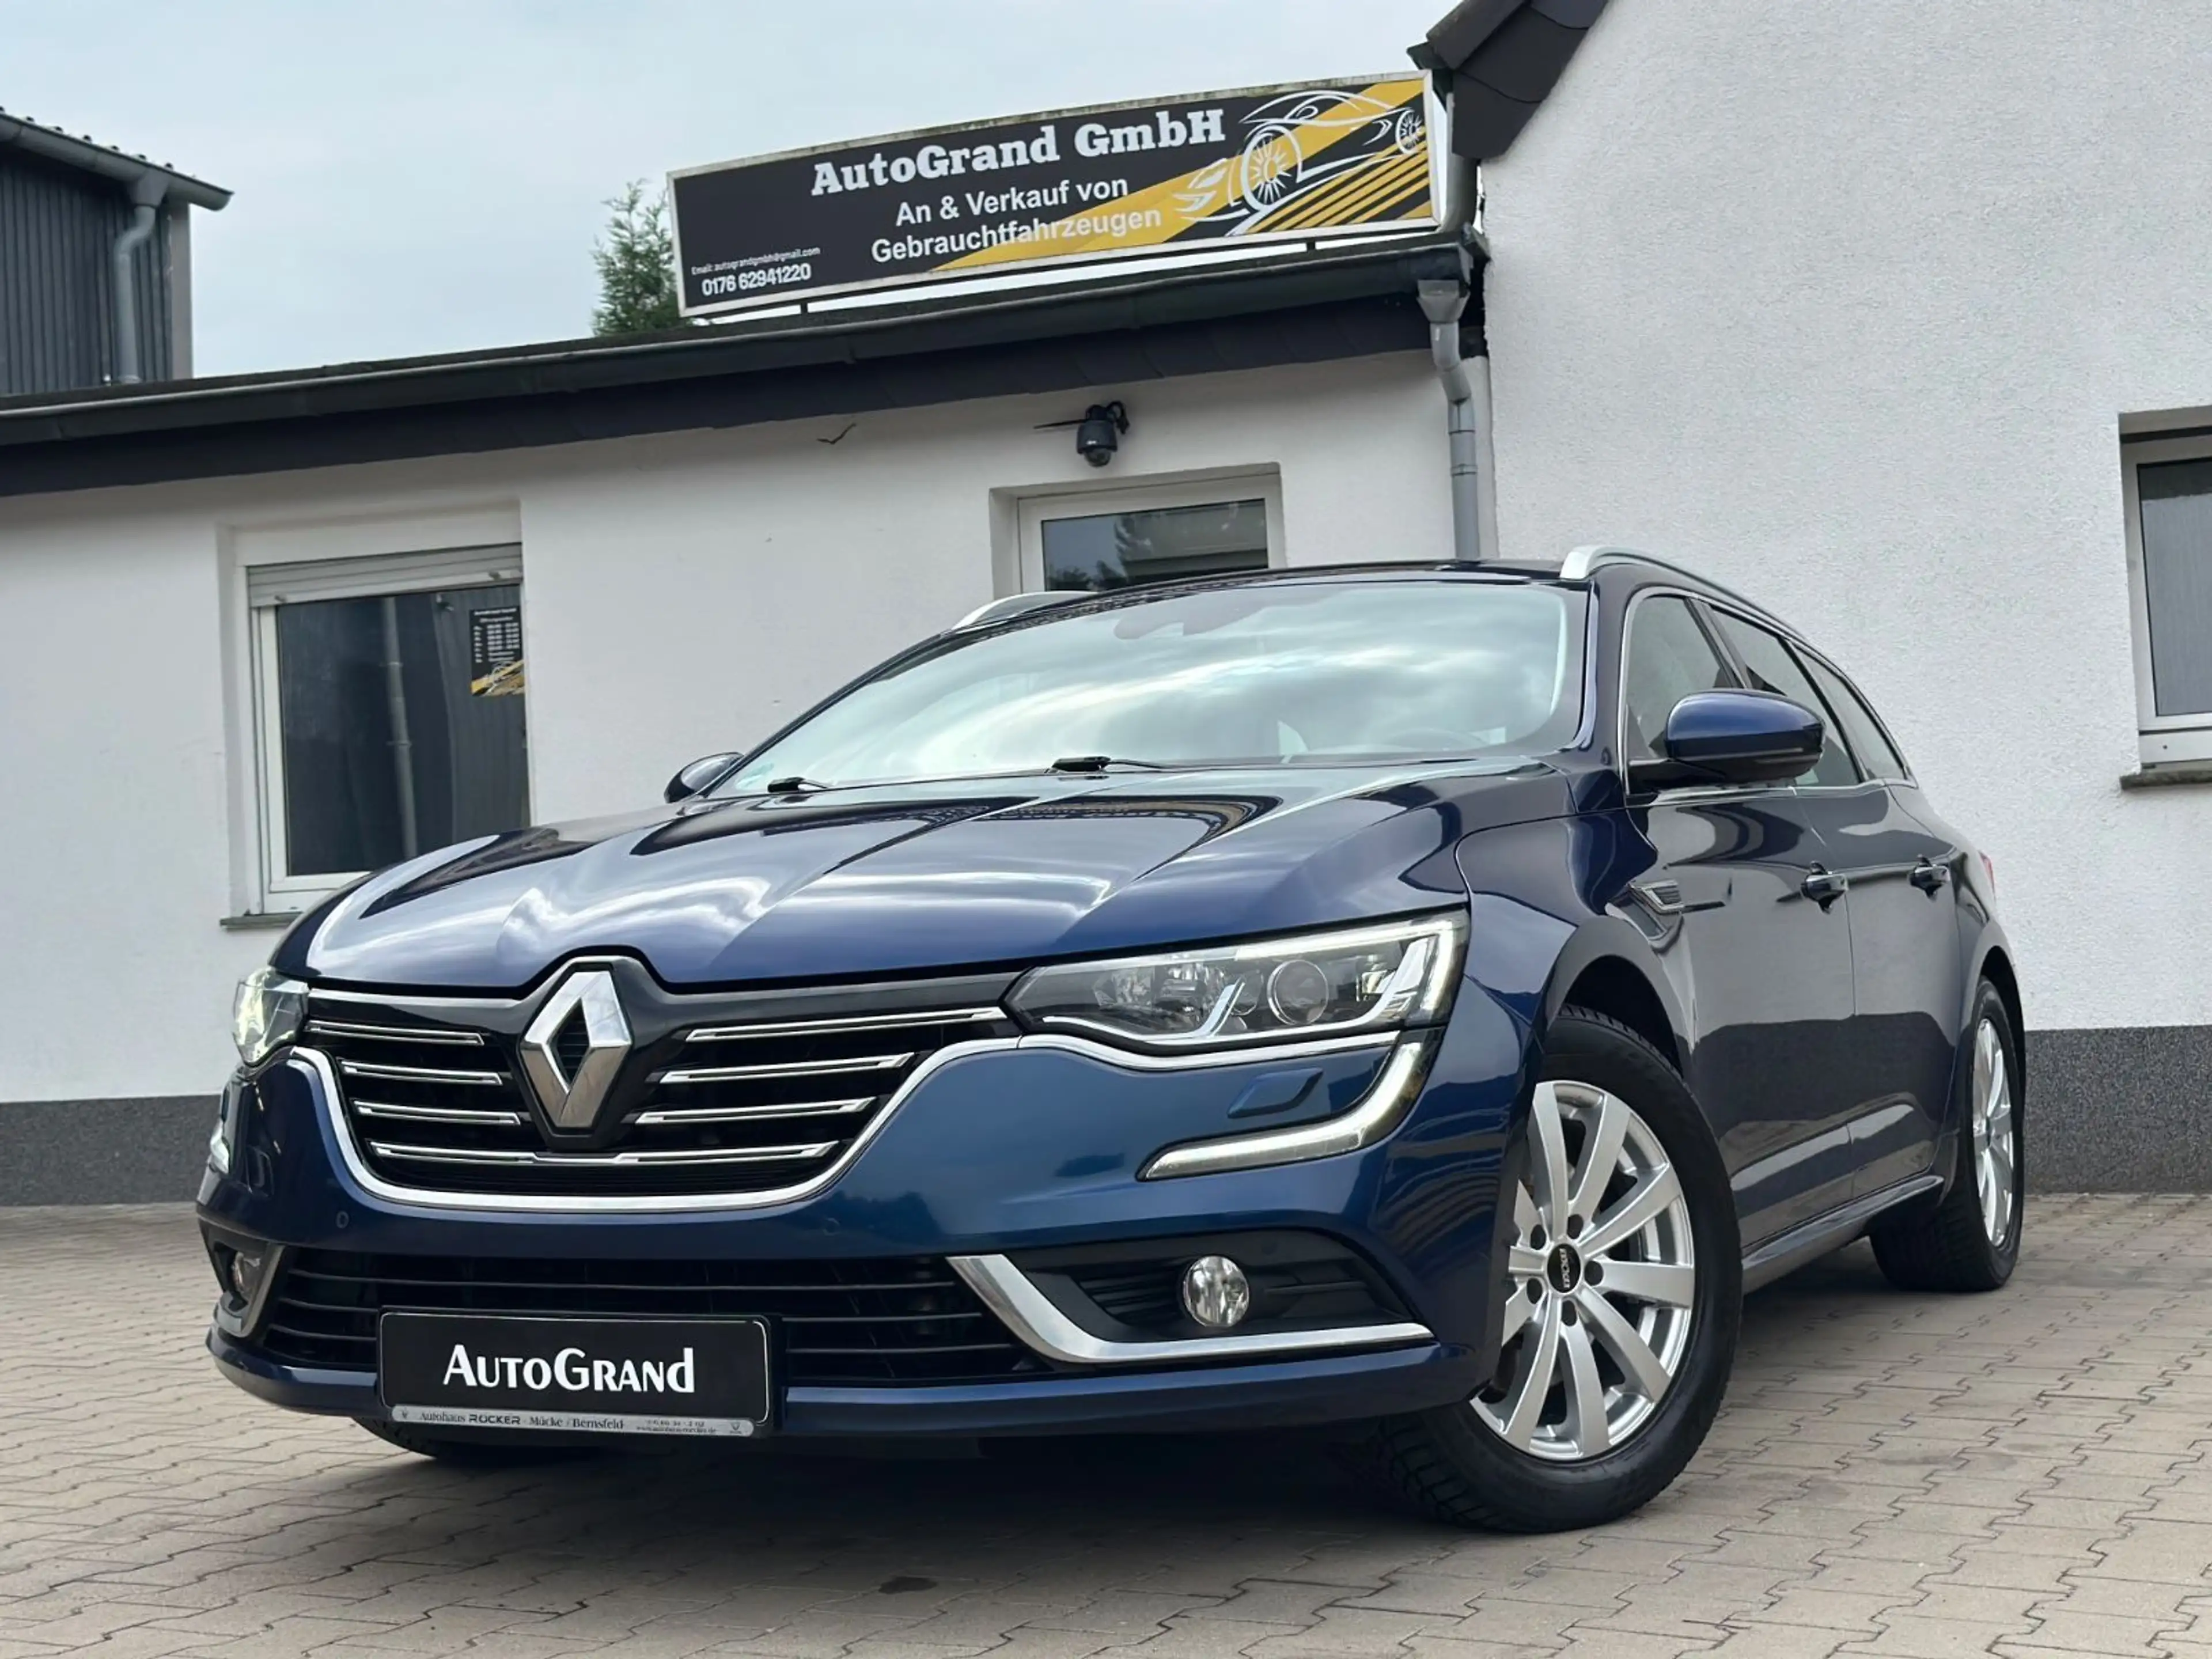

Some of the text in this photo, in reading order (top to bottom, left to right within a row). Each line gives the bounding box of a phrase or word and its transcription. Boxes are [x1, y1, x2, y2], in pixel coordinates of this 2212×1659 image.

[811, 109, 1226, 196] AutoGrand GmbH
[895, 178, 1128, 226] An & Verkauf von
[871, 209, 1162, 263] Gebrauchtfahrzeugen
[701, 262, 812, 296] 0176 62941220
